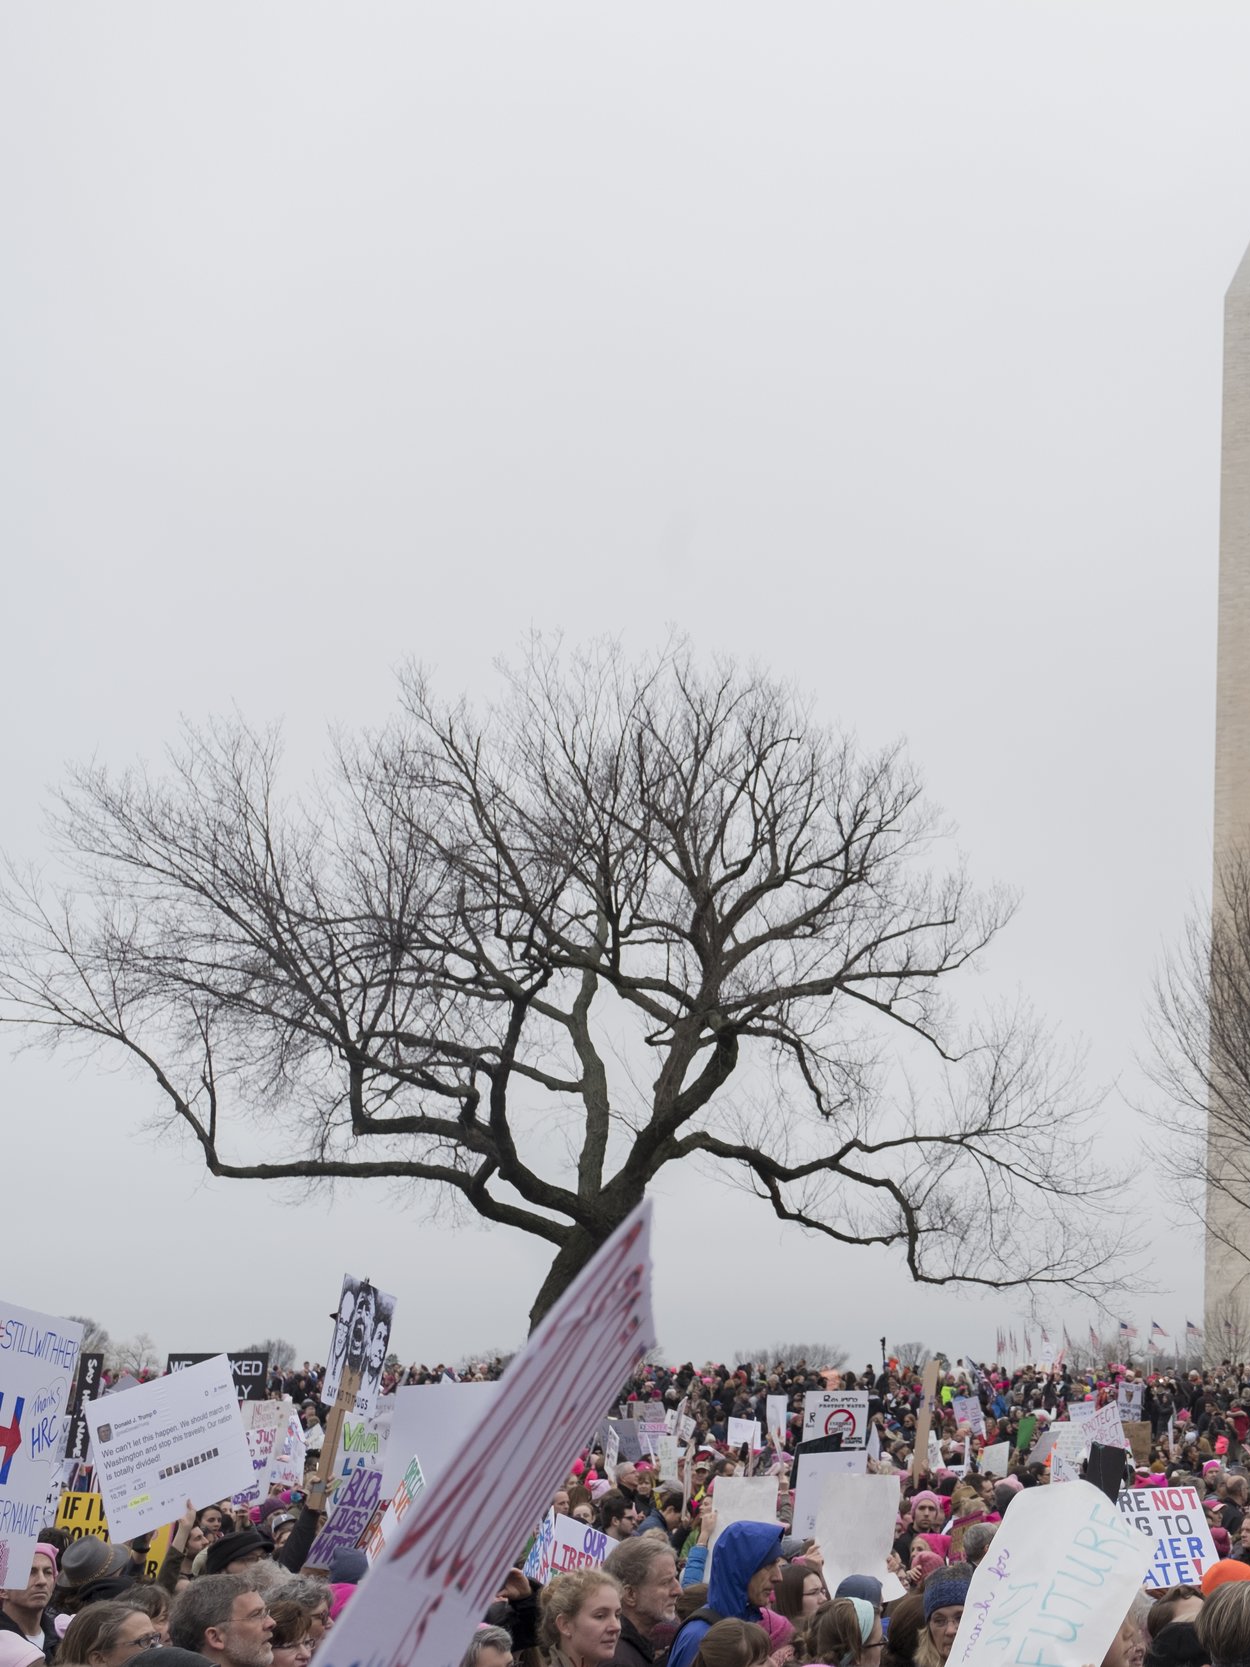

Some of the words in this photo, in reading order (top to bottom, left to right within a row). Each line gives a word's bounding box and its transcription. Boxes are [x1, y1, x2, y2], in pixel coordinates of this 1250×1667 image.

[32, 1415, 58, 1459] HRC
[101, 1447, 114, 1458] We
[115, 1441, 133, 1455] can't
[133, 1438, 142, 1448] let
[142, 1434, 155, 1445] this
[155, 1424, 178, 1441] happen.
[179, 1419, 191, 1430] We
[190, 1413, 209, 1426] should
[208, 1407, 224, 1418] march
[224, 1403, 232, 1412] on
[1081, 1405, 1116, 1437] PROTECT
[103, 1450, 145, 1471] Washington
[145, 1445, 159, 1456] and
[158, 1439, 173, 1451] stop
[172, 1433, 185, 1444] this
[184, 1424, 206, 1442] travesty.
[207, 1420, 218, 1430] Our
[217, 1413, 233, 1426] nation
[106, 1472, 114, 1482] is
[113, 1465, 135, 1479] totally
[135, 1453, 161, 1471] divided!
[339, 1467, 383, 1511] BLACK
[1119, 1491, 1151, 1513] RE
[1151, 1488, 1197, 1512] NOT
[62, 1496, 83, 1520] IF
[85, 1498, 95, 1521] I
[323, 1506, 369, 1537] LIVES
[1158, 1514, 1194, 1536] TO
[583, 1527, 608, 1563] OUR
[1014, 1503, 1140, 1667] FUTURE
[962, 1591, 995, 1662] march
[988, 1548, 1011, 1581] for
